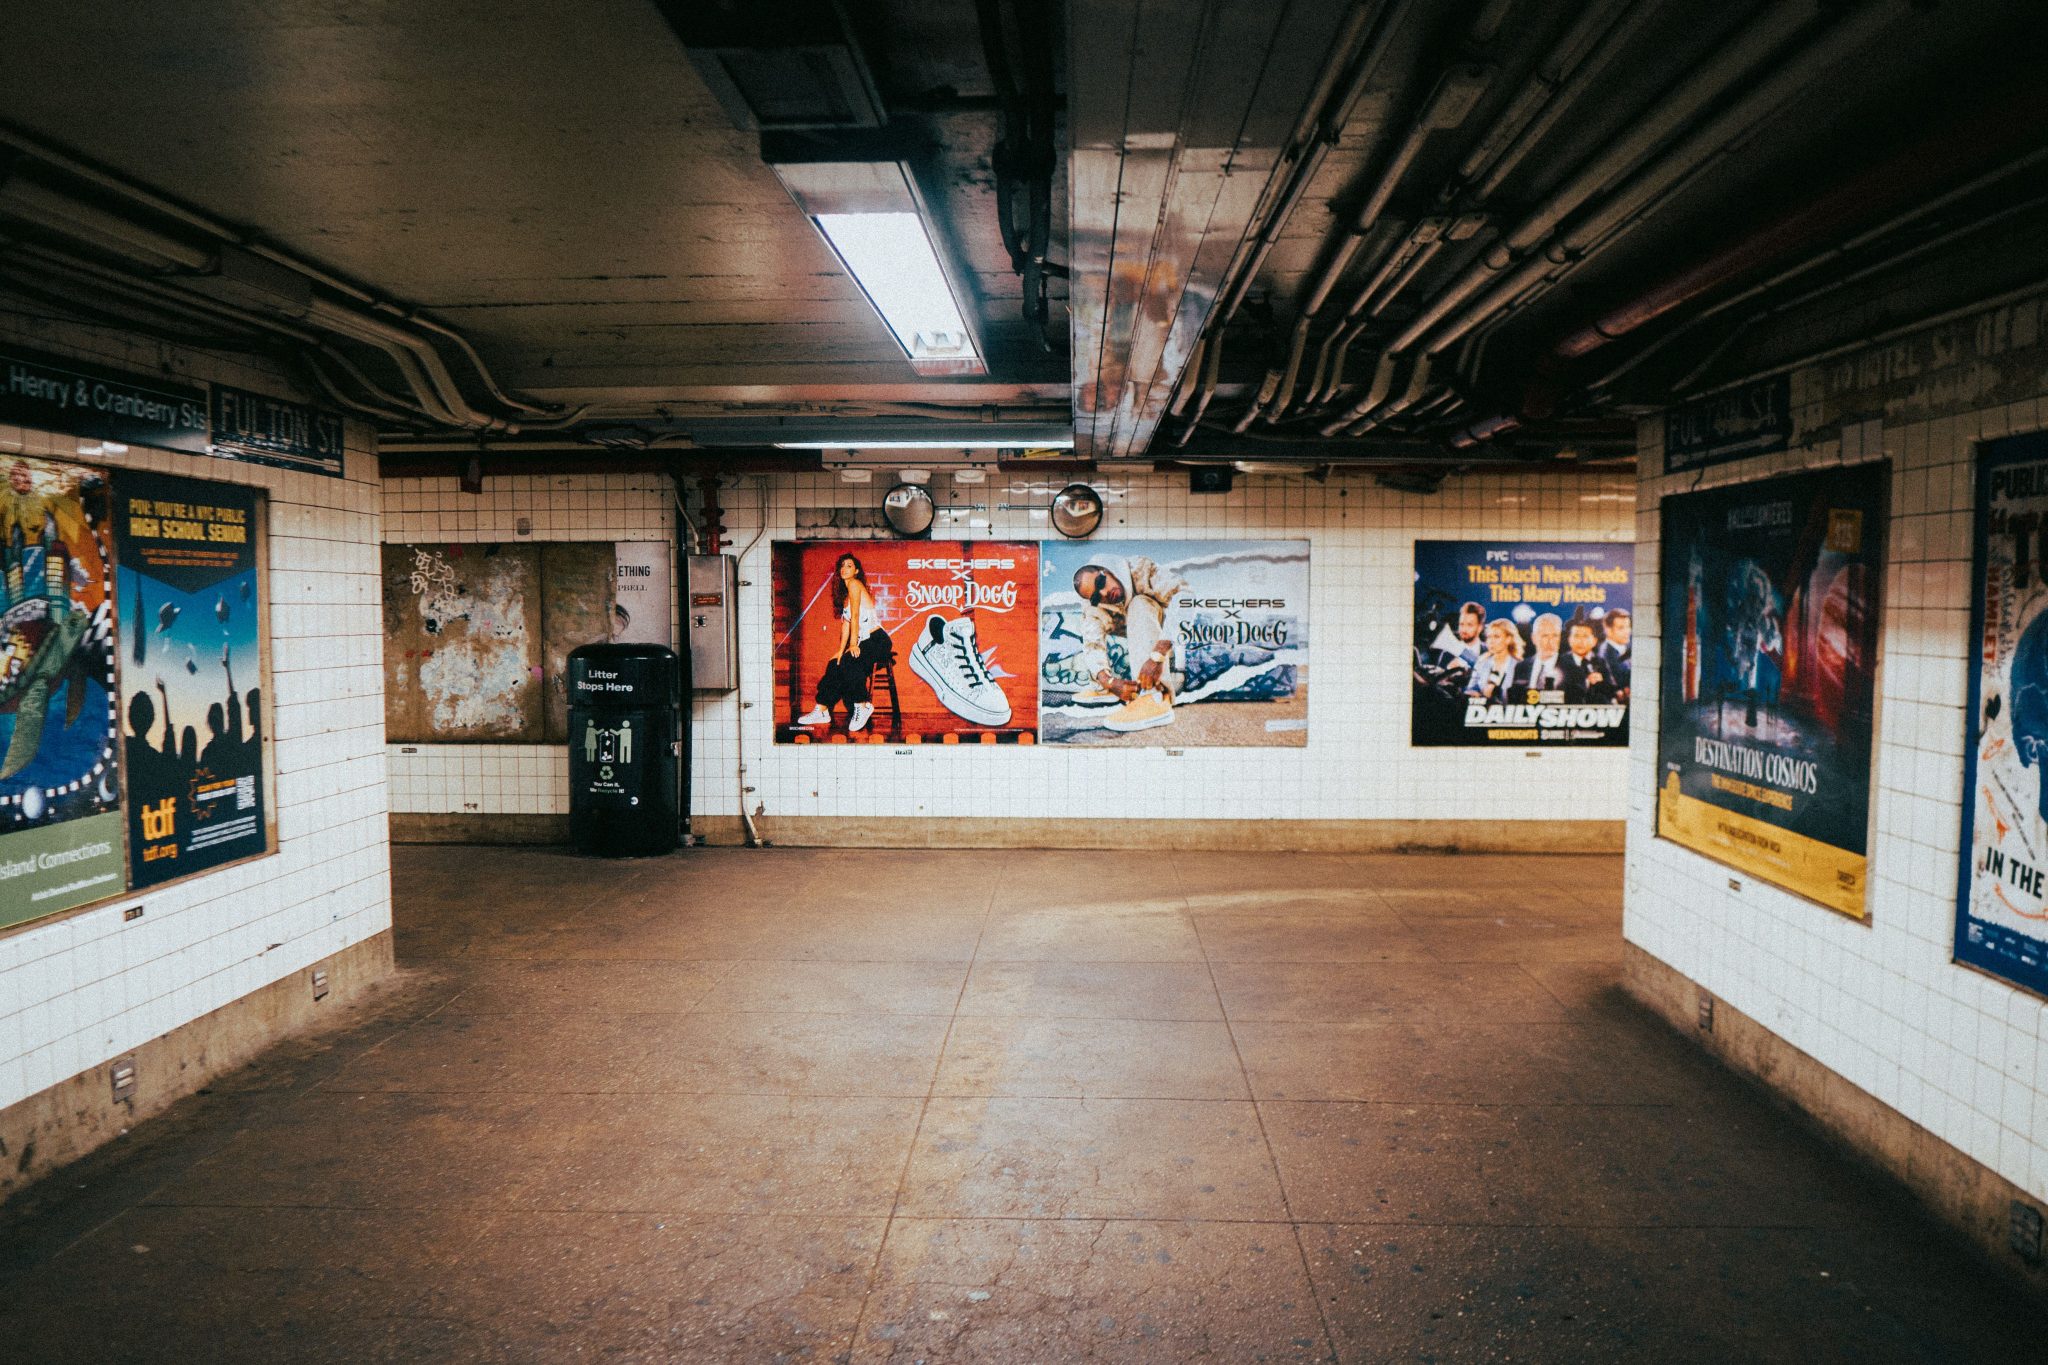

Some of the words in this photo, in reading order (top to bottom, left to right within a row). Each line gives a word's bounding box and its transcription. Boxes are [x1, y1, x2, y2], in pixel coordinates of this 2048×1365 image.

[9, 364, 69, 408] Henry
[75, 379, 91, 407] &
[93, 385, 177, 429] Cranberry
[181, 402, 206, 429] Sts
[220, 391, 311, 450] FULTON
[216, 508, 246, 524] PUBLIC
[129, 517, 160, 538] HIGH
[162, 520, 207, 541] SCHOOL
[208, 524, 247, 544] SENIOR
[907, 558, 1015, 570] SKECHERS
[1486, 550, 1509, 561] FYC
[616, 564, 651, 577] ETHING
[950, 569, 972, 581] X
[1468, 565, 1499, 583] This
[1501, 565, 1541, 583] Much
[1543, 565, 1581, 583] News
[1583, 565, 1629, 584] Needs
[906, 580, 962, 609] SNOOP
[963, 580, 1018, 609] DOGG
[1179, 598, 1286, 609] SKECHERS
[1489, 584, 1521, 602] This
[1522, 584, 1562, 606] Many
[1563, 584, 1606, 603] Hosts
[1223, 609, 1242, 619] X
[1984, 566, 2000, 662] HAMLET
[1177, 619, 1234, 645] SNOOP
[1235, 620, 1288, 646] DOGG
[588, 669, 618, 680] Litter
[577, 680, 604, 692] Stops
[605, 683, 634, 692] Here
[1464, 704, 1545, 727] DAILY
[1539, 704, 1626, 728] SHOW
[1487, 729, 1538, 740] WEEKNIGHTS
[1694, 735, 1765, 780] DESTINATION
[1764, 752, 1818, 795] COSMOS
[141, 796, 177, 841] tdf
[37, 841, 112, 870] Connections
[142, 844, 178, 862] tdf.org
[1985, 846, 2005, 879] IN
[2009, 857, 2045, 899] THE
